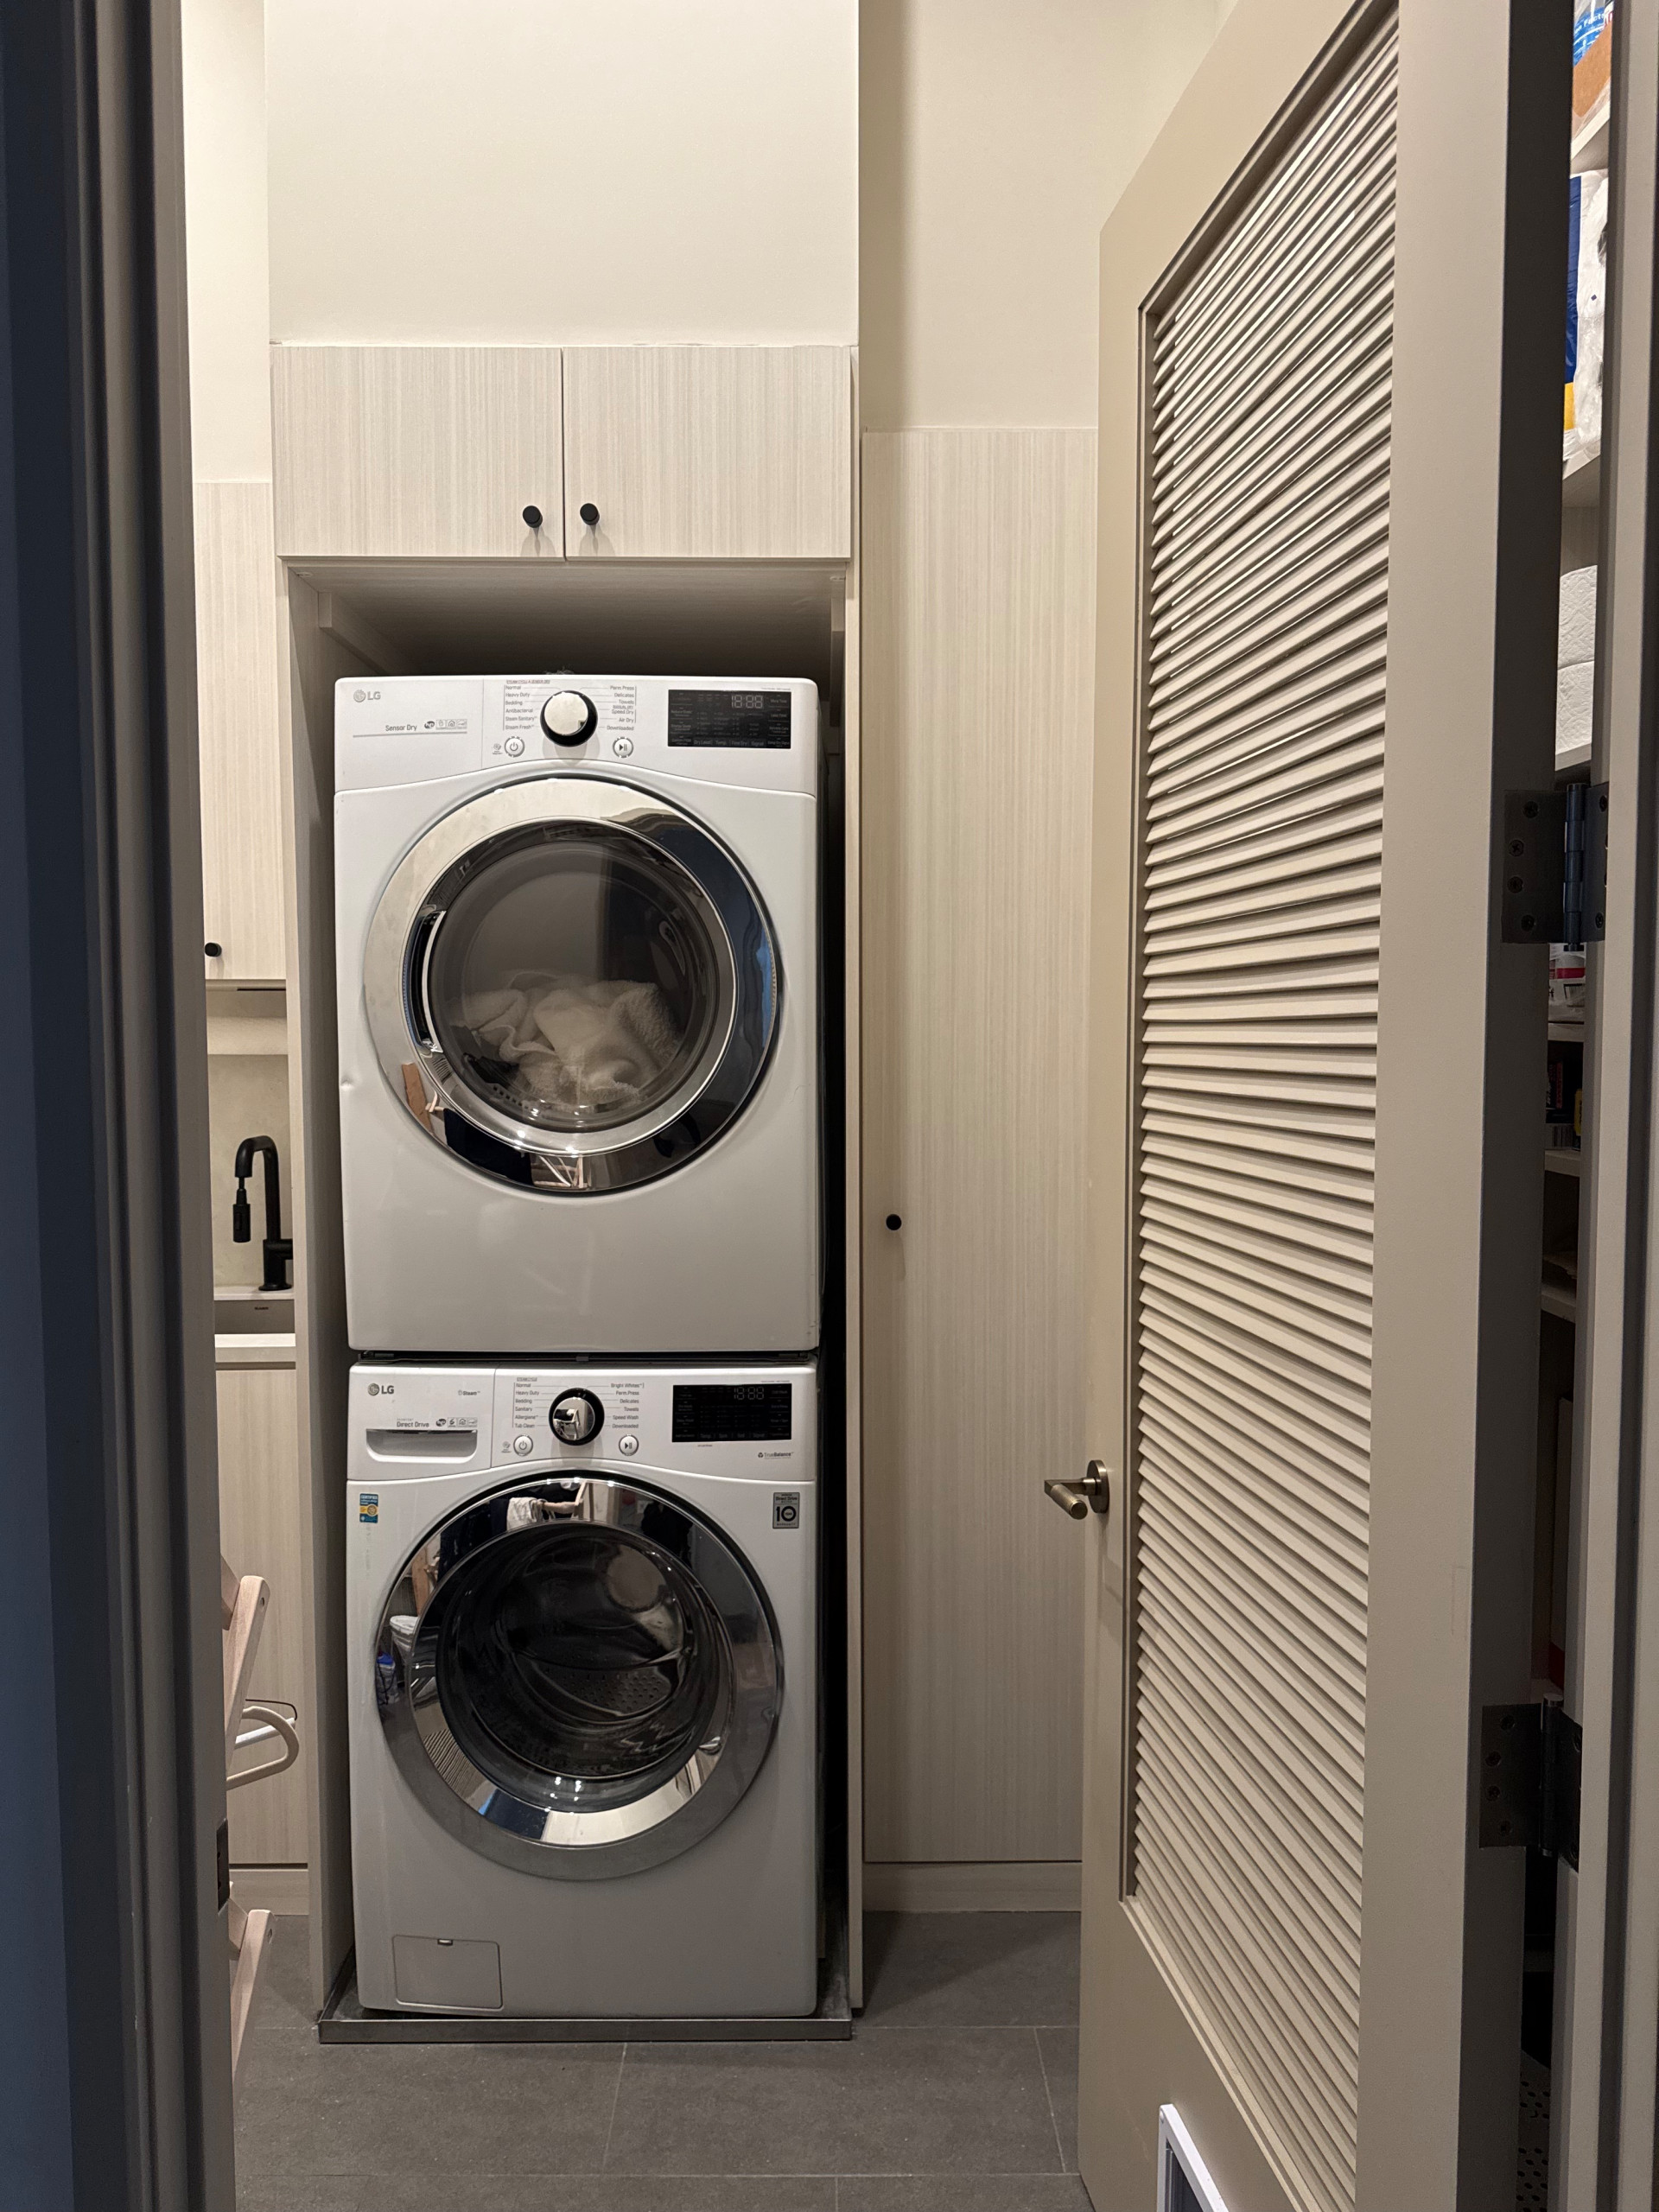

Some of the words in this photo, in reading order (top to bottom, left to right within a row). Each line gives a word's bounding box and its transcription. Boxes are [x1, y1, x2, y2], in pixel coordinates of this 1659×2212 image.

[367, 691, 381, 700] LG
[381, 1385, 394, 1394] LG
[776, 1506, 797, 1522] 10
